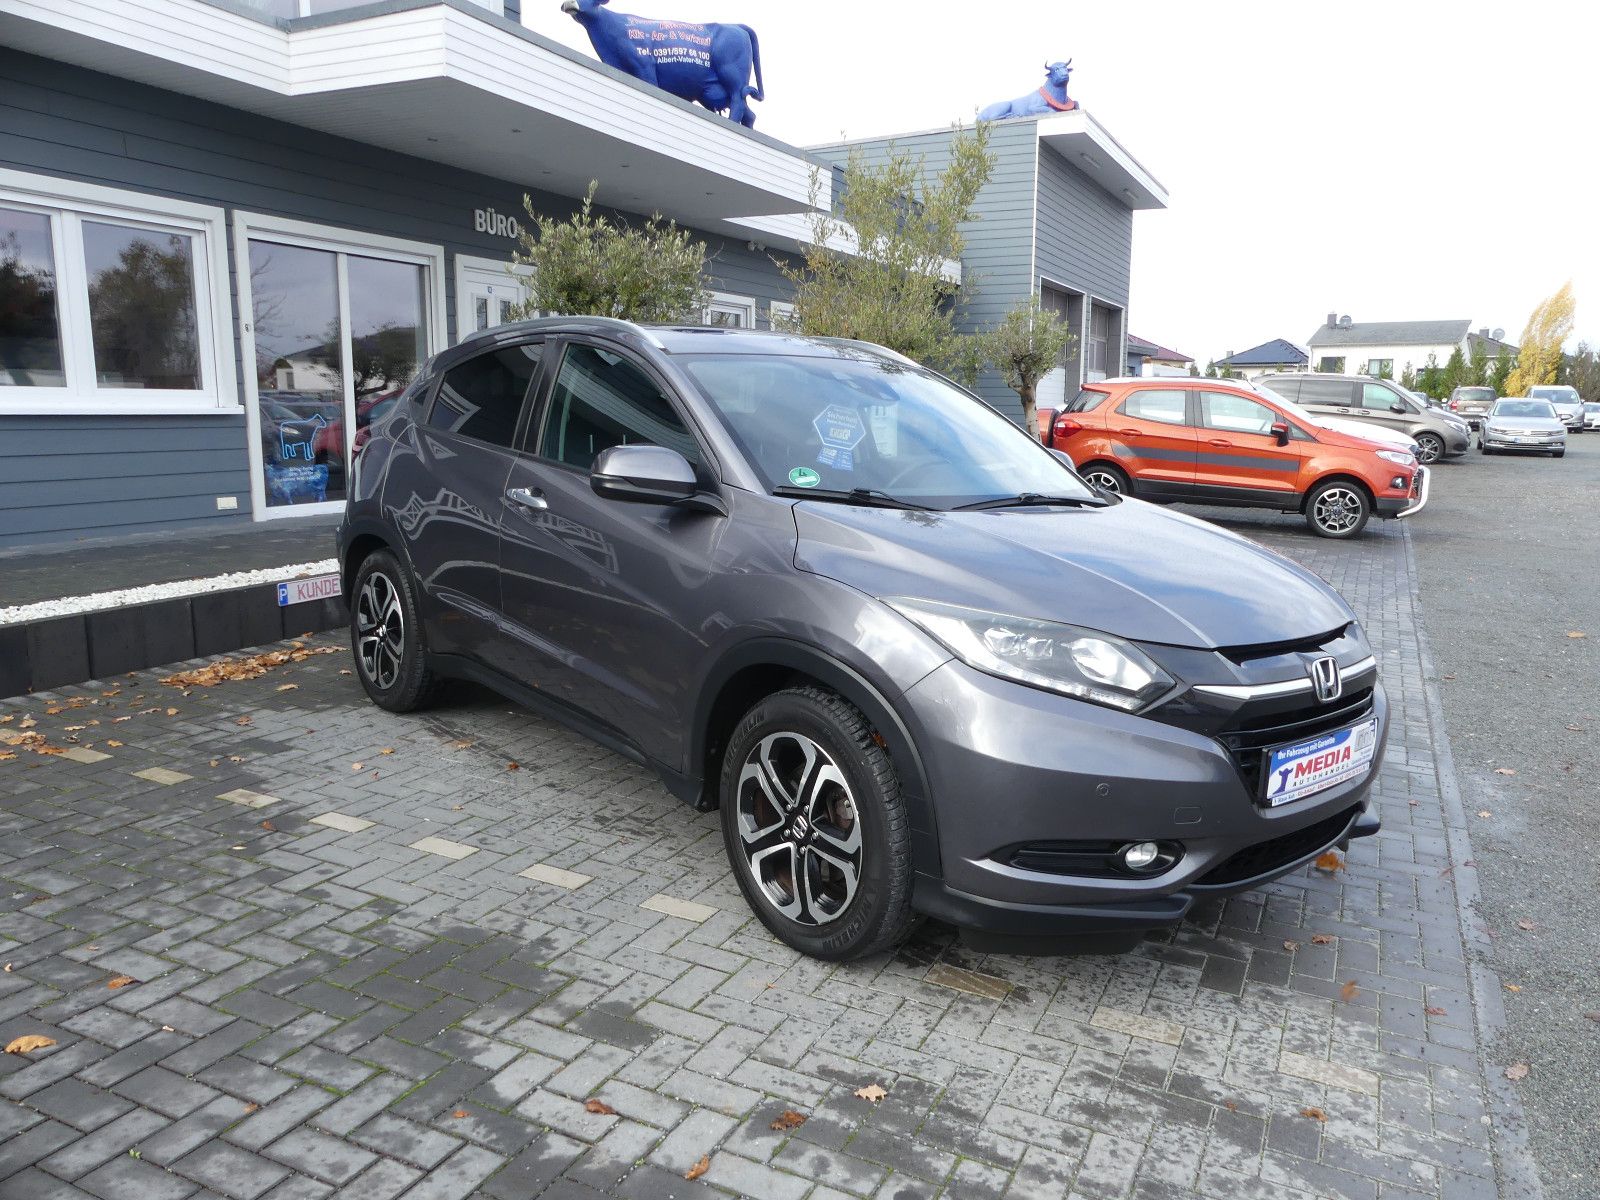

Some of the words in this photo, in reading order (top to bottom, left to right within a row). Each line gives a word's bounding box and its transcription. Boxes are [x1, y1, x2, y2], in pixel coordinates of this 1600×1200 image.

[637, 47, 651, 57] Tel.
[698, 51, 710, 61] 100
[474, 207, 518, 239] BÜRO
[279, 588, 288, 601] P
[297, 578, 341, 600] KUNDE
[1294, 745, 1351, 779] MEDIA
[1292, 763, 1351, 787] AUTOHANDEL
